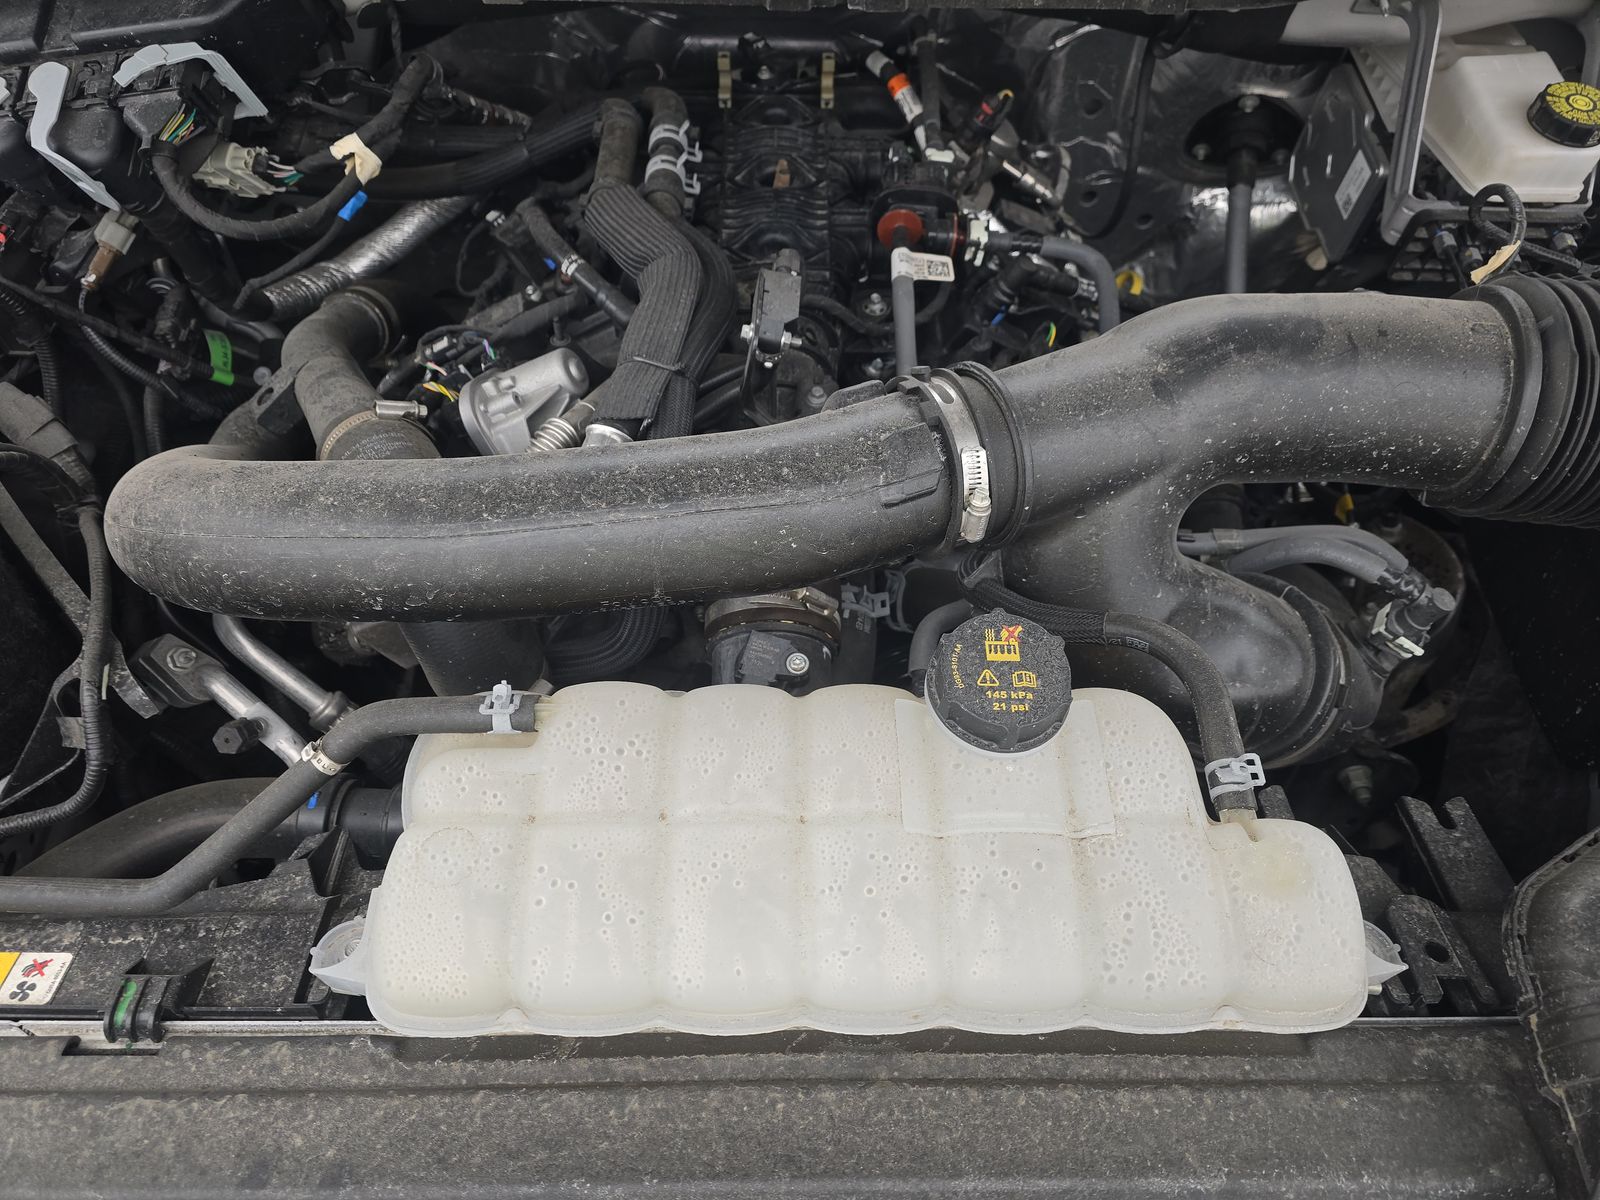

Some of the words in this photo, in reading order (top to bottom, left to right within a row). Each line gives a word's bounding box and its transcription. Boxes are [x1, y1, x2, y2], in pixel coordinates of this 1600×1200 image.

[985, 690, 1007, 699] 145
[1010, 691, 1033, 700] kPa
[992, 703, 1007, 711] 21
[1011, 703, 1029, 712] psi
